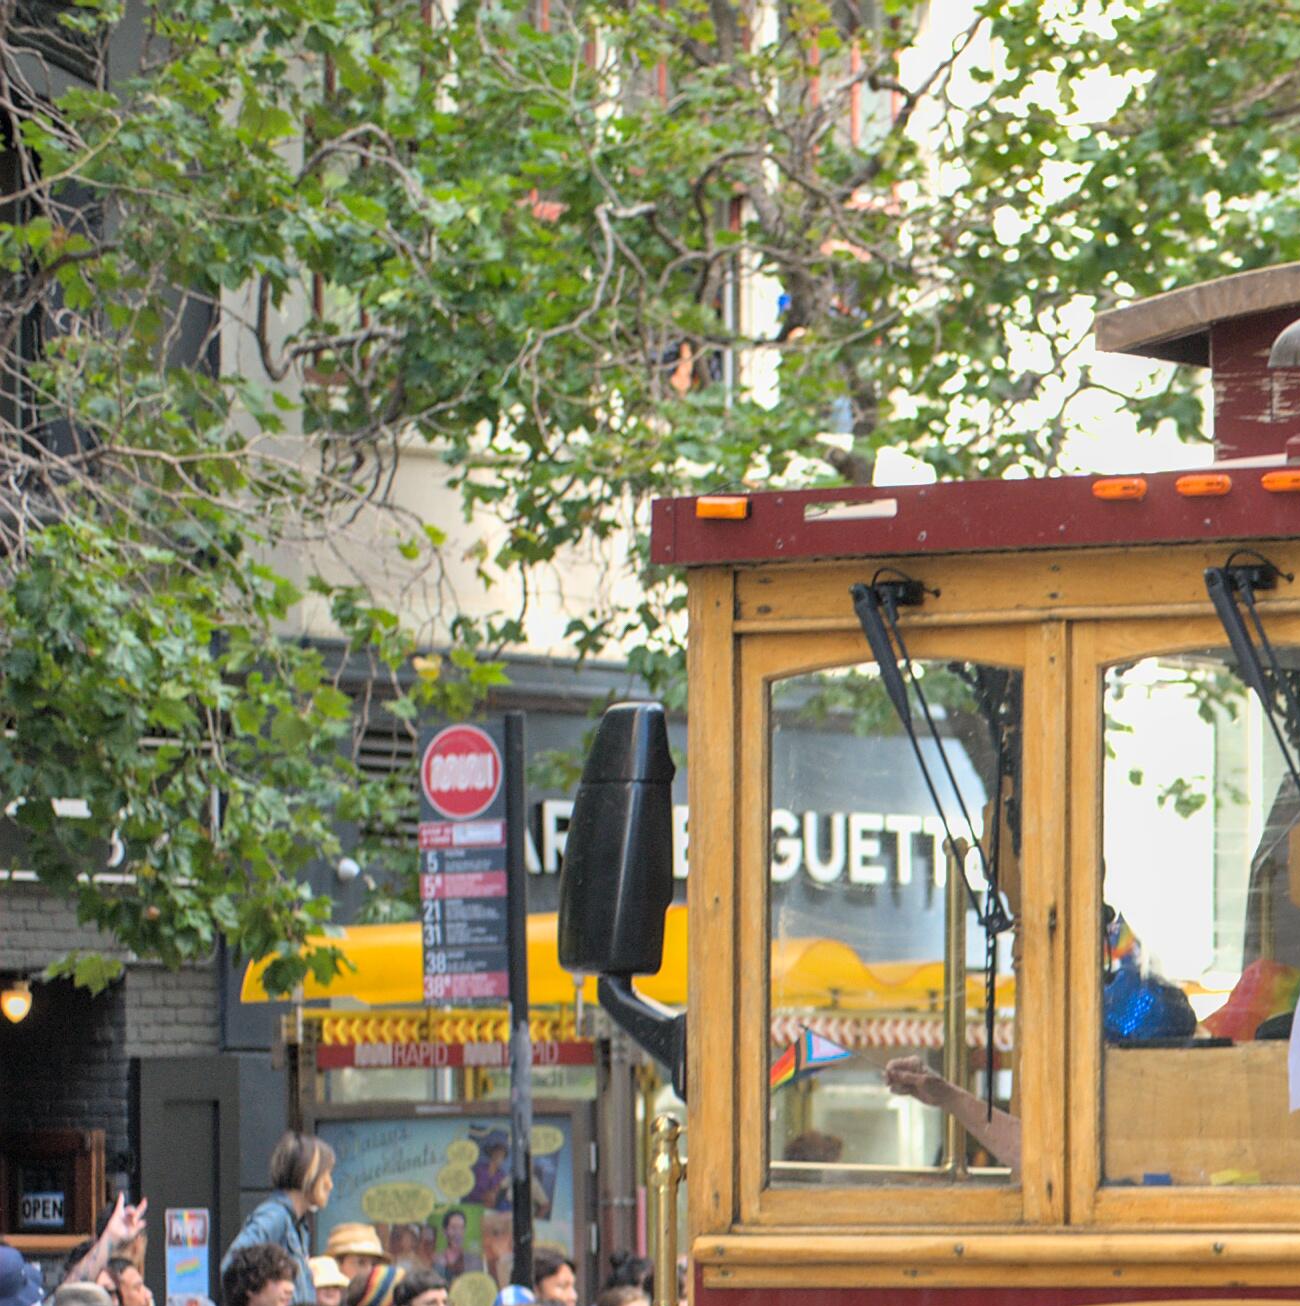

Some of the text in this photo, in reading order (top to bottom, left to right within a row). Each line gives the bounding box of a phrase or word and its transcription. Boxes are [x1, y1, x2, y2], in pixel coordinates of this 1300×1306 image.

[427, 851, 438, 872] 5
[423, 900, 440, 922] 21
[424, 924, 441, 946] 31
[425, 951, 446, 974] 38
[394, 1041, 449, 1067] RAPID
[22, 1200, 64, 1219] OPEN
